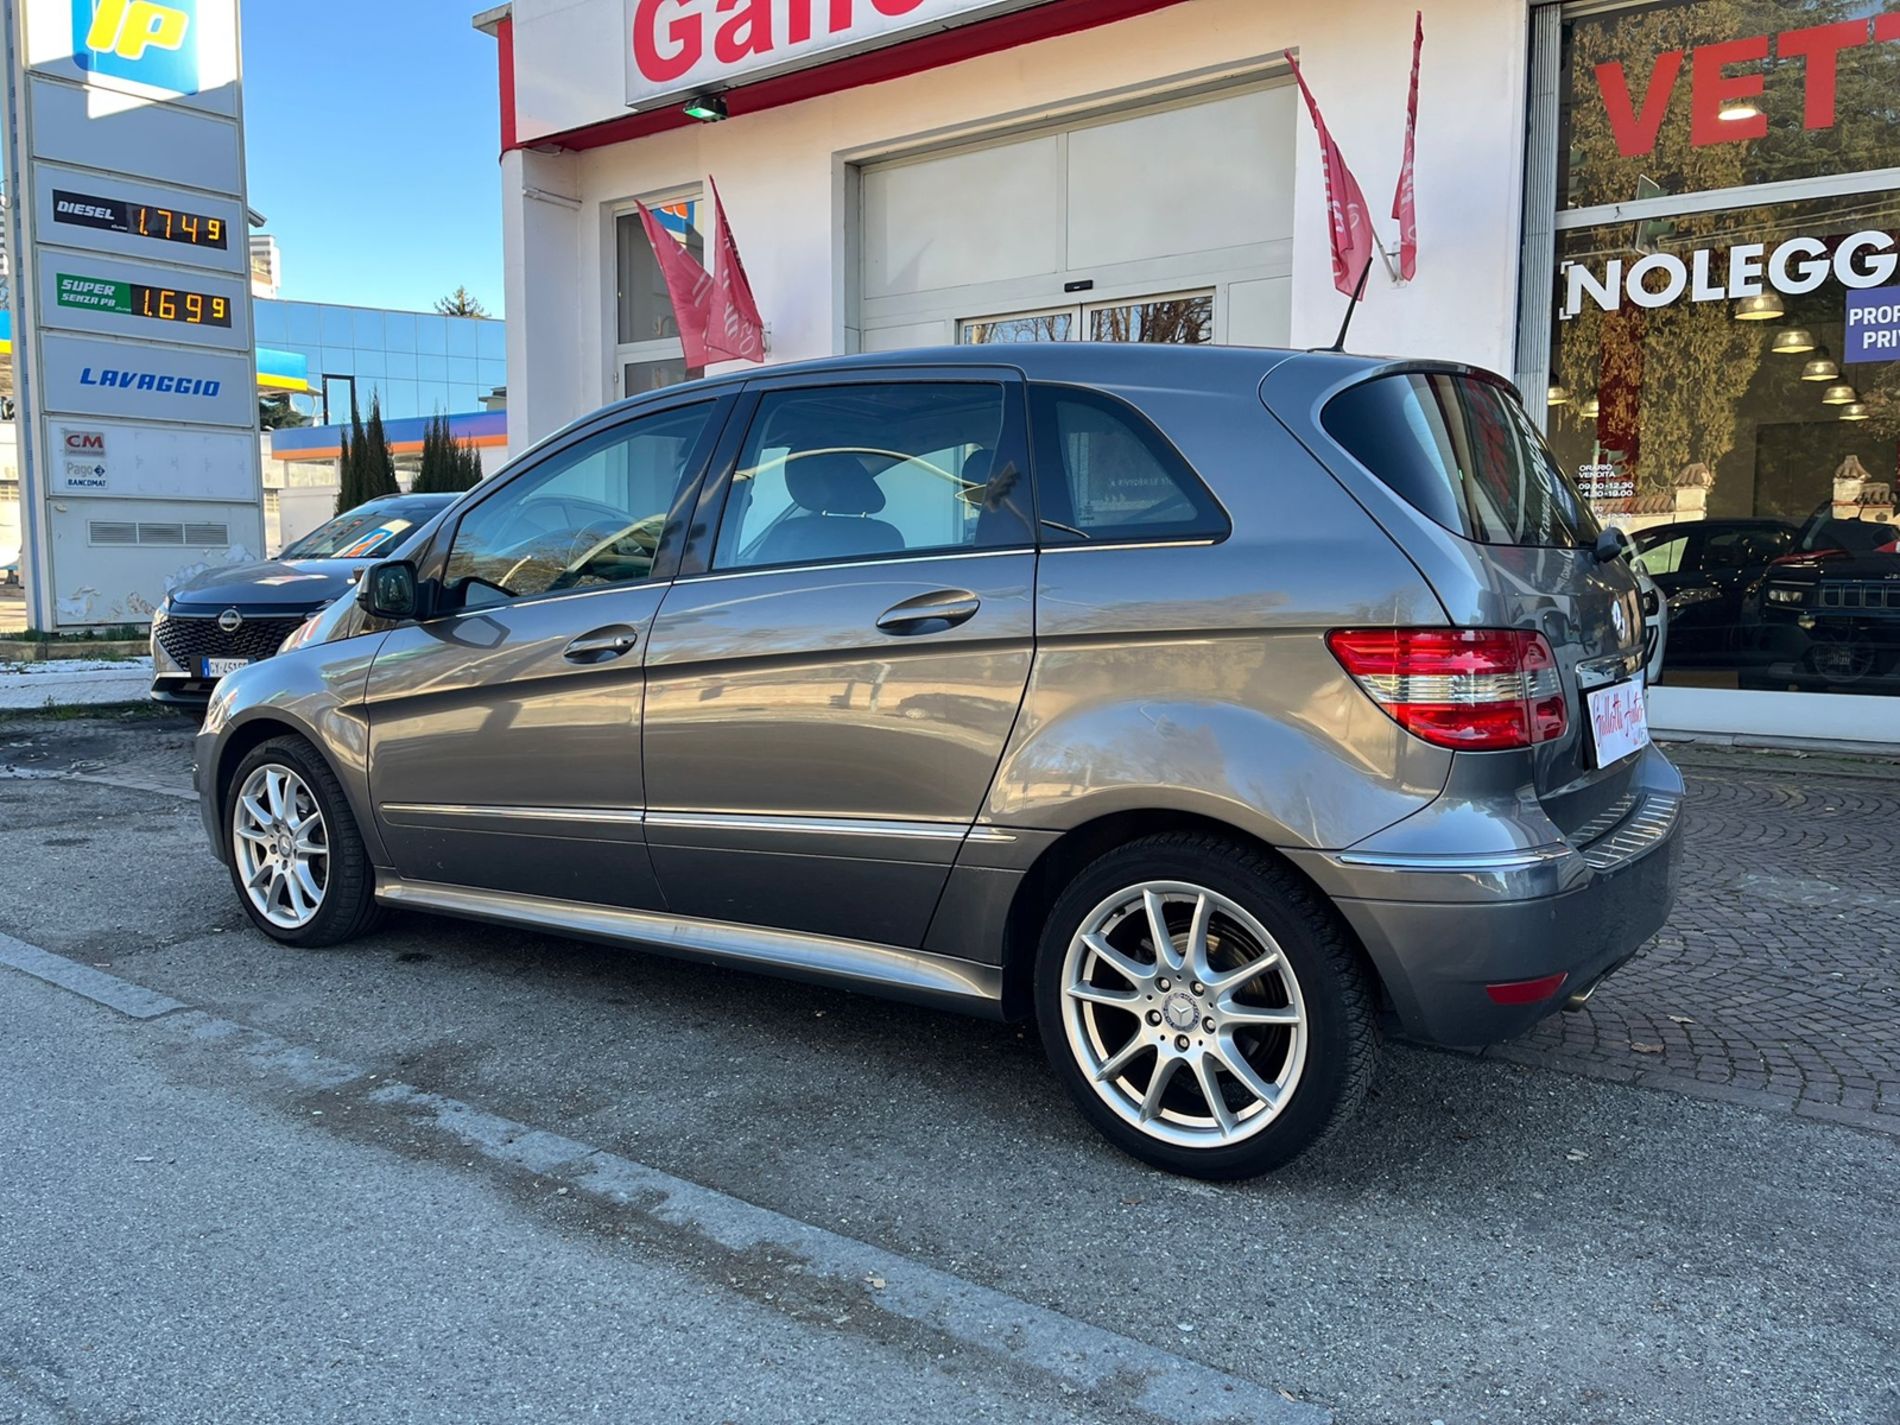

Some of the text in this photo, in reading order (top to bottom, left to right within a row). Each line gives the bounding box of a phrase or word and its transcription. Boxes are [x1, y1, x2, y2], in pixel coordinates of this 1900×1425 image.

[1594, 12, 1900, 158] VET
[57, 200, 221, 243] DIESEL 1.749
[1566, 230, 1898, 315] NOLEGG
[61, 293, 98, 305] SENZA
[61, 279, 224, 323] SUPER 1.699
[1863, 329, 1900, 349] PRI
[80, 367, 220, 397] LAVAGGIO
[66, 434, 104, 448] CM
[67, 462, 93, 477] Pago
[68, 478, 106, 487] BANCOMAT
